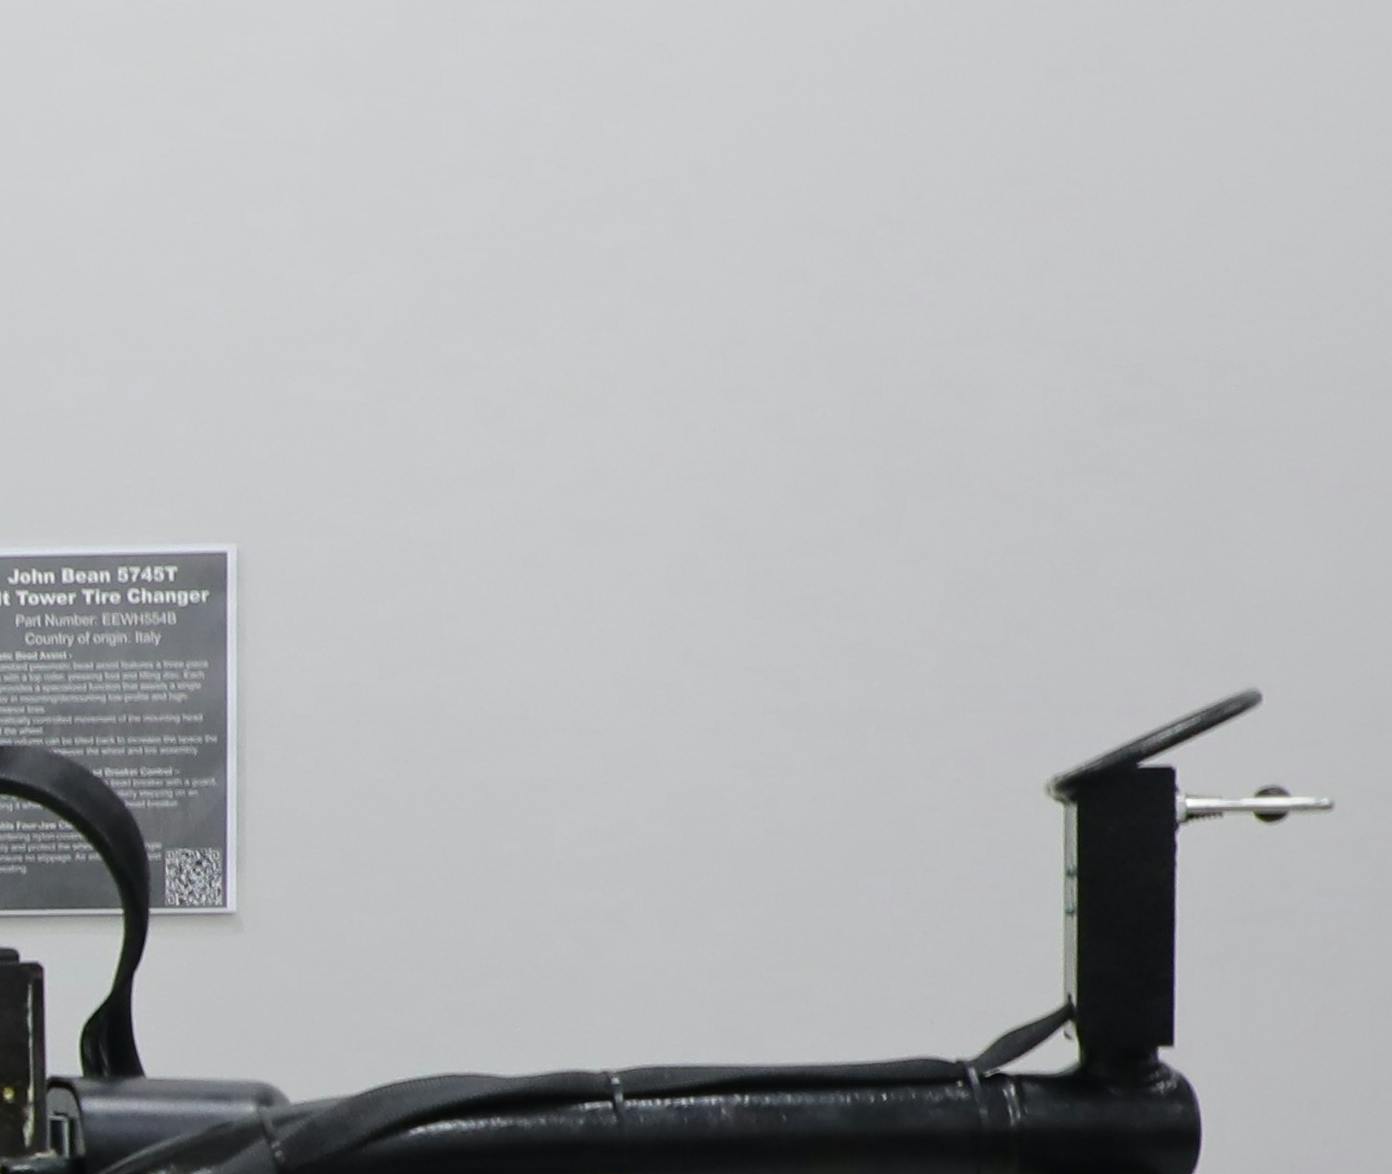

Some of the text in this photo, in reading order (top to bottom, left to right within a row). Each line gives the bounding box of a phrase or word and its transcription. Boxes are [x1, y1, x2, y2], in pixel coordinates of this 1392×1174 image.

[8, 566, 178, 585] John Bean 5745T
[16, 590, 77, 607] Tower
[82, 589, 121, 605] Tire
[127, 588, 210, 607] Changer
[15, 614, 41, 628] Part
[45, 614, 96, 627] Number:
[25, 632, 73, 647] Country
[77, 632, 90, 645] of
[135, 631, 162, 646] Italy
